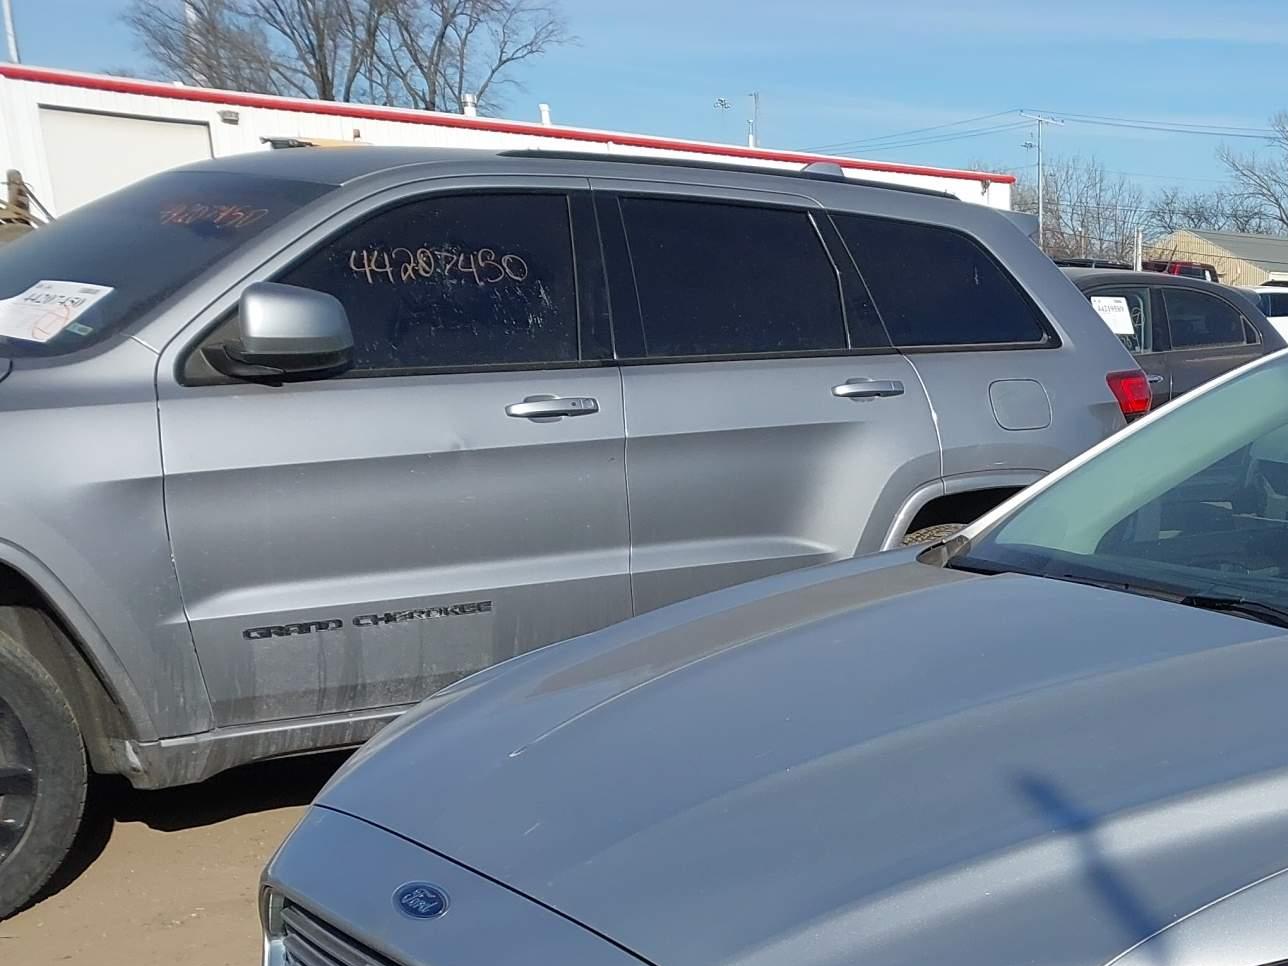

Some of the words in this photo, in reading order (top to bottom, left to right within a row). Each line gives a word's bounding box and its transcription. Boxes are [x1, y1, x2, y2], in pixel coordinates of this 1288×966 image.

[243, 618, 343, 641] GRAND
[352, 600, 492, 627] CHEROKEE
[401, 888, 439, 913] Ford
